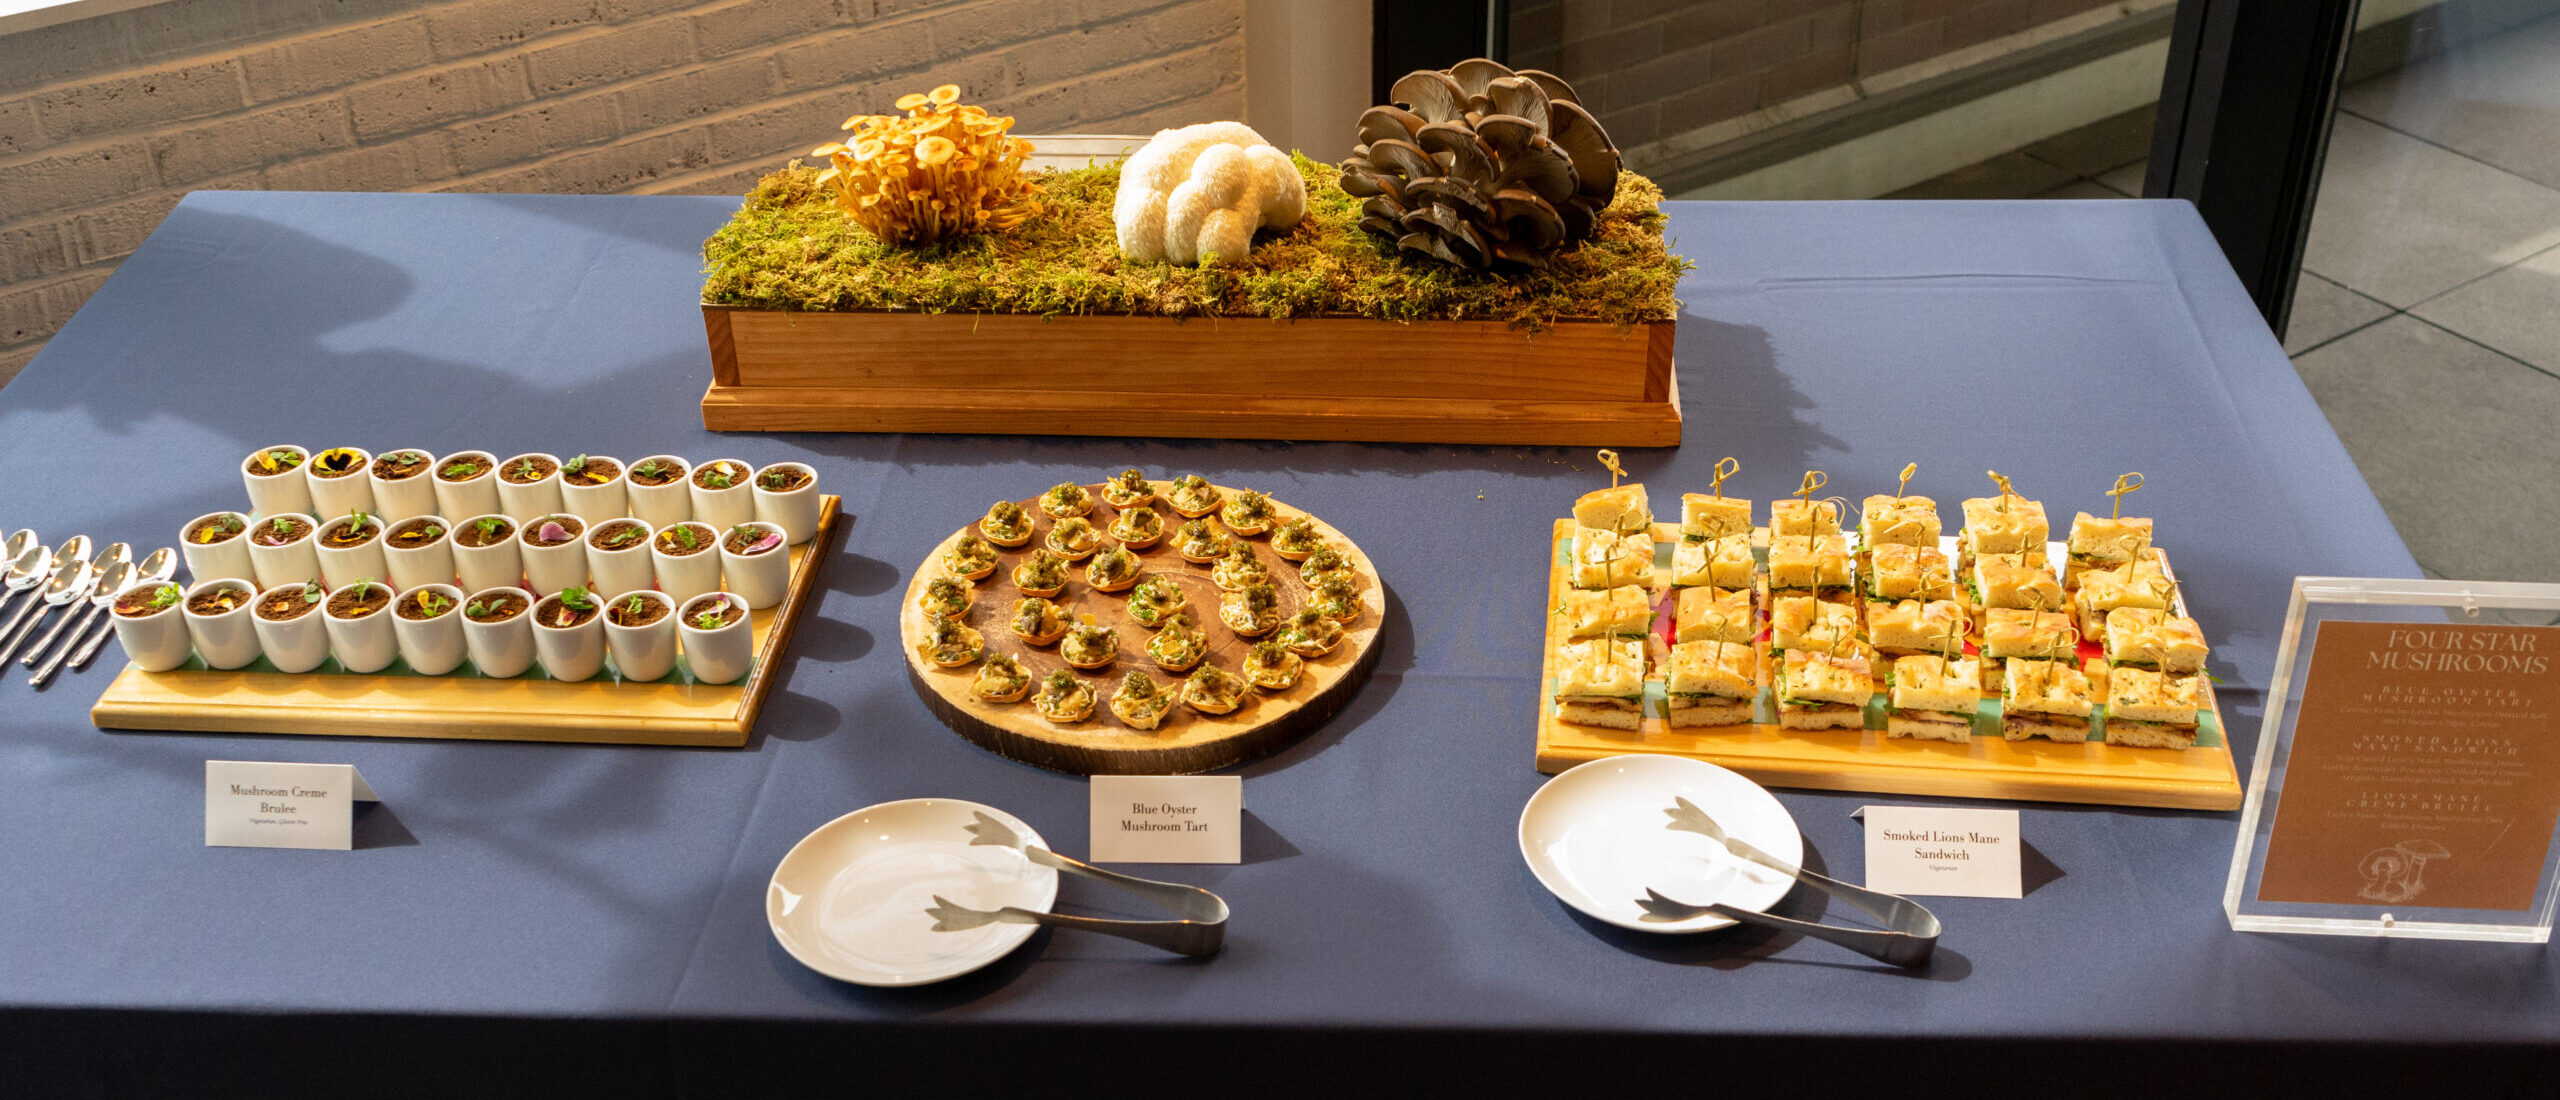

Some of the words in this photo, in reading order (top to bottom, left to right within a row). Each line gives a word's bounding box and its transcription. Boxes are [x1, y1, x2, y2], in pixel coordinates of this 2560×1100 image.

[2388, 629, 2463, 650] FOUR
[2469, 632, 2537, 652] STAR
[2366, 651, 2549, 674] MUSHROOMS
[2382, 685, 2430, 696] BLUE
[2443, 687, 2519, 698] OYSTER
[2363, 694, 2473, 706] MUSHROOM
[2487, 698, 2534, 708] TART
[2361, 735, 2440, 745] SMOKED
[2453, 737, 2513, 747] LIONS
[2352, 742, 2402, 751] MANE
[2414, 745, 2519, 756] SANDWICH
[230, 784, 289, 797] Mushroom
[291, 786, 328, 798] Creme
[2361, 791, 2419, 801] LIONS
[260, 802, 297, 814] Brulee
[1132, 802, 1158, 814] Blue
[1161, 803, 1197, 818] Oyster
[1121, 820, 1181, 832] Mushroom
[1184, 820, 1209, 832] Tart
[1883, 828, 1929, 842] Smoked
[1933, 831, 1965, 843] Lions
[1968, 832, 2000, 844] Mane
[1914, 847, 1970, 861] Sandwich
